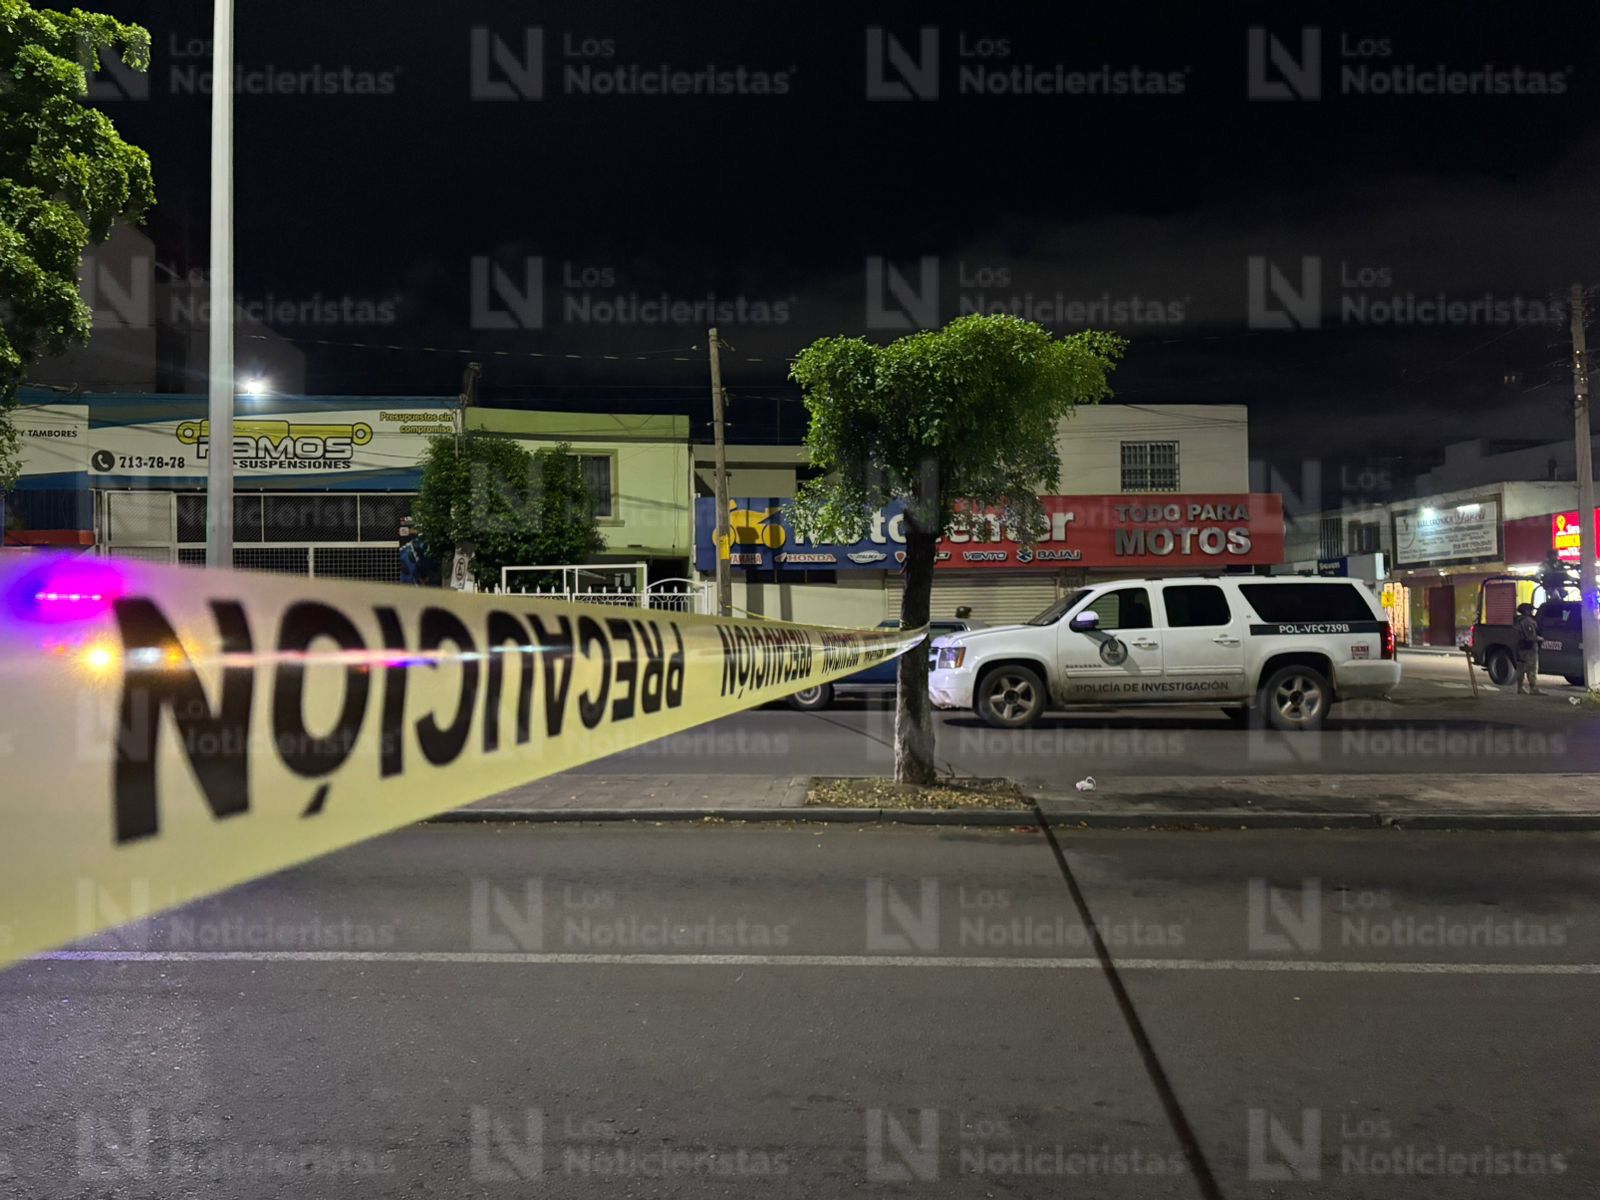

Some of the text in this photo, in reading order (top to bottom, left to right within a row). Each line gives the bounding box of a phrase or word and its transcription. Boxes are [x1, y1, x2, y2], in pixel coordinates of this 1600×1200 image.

[380, 411, 453, 423] Presupuestos sin
[28, 429, 78, 438] TAMBORES
[400, 424, 452, 435] compromiso
[119, 456, 185, 469] 713-78-78
[239, 460, 351, 469] SUSPENSIONES
[1115, 503, 1181, 523] TODO
[1187, 502, 1250, 522] PARA
[1114, 527, 1252, 556] MOTOS
[788, 553, 835, 562] HONDA
[964, 552, 1007, 561] VENTO
[1037, 551, 1080, 560] BAJAJ
[1076, 680, 1229, 693] POLICÍA DE INVESTIGACIÓN
[113, 596, 686, 846] PRECAUCIÓN
